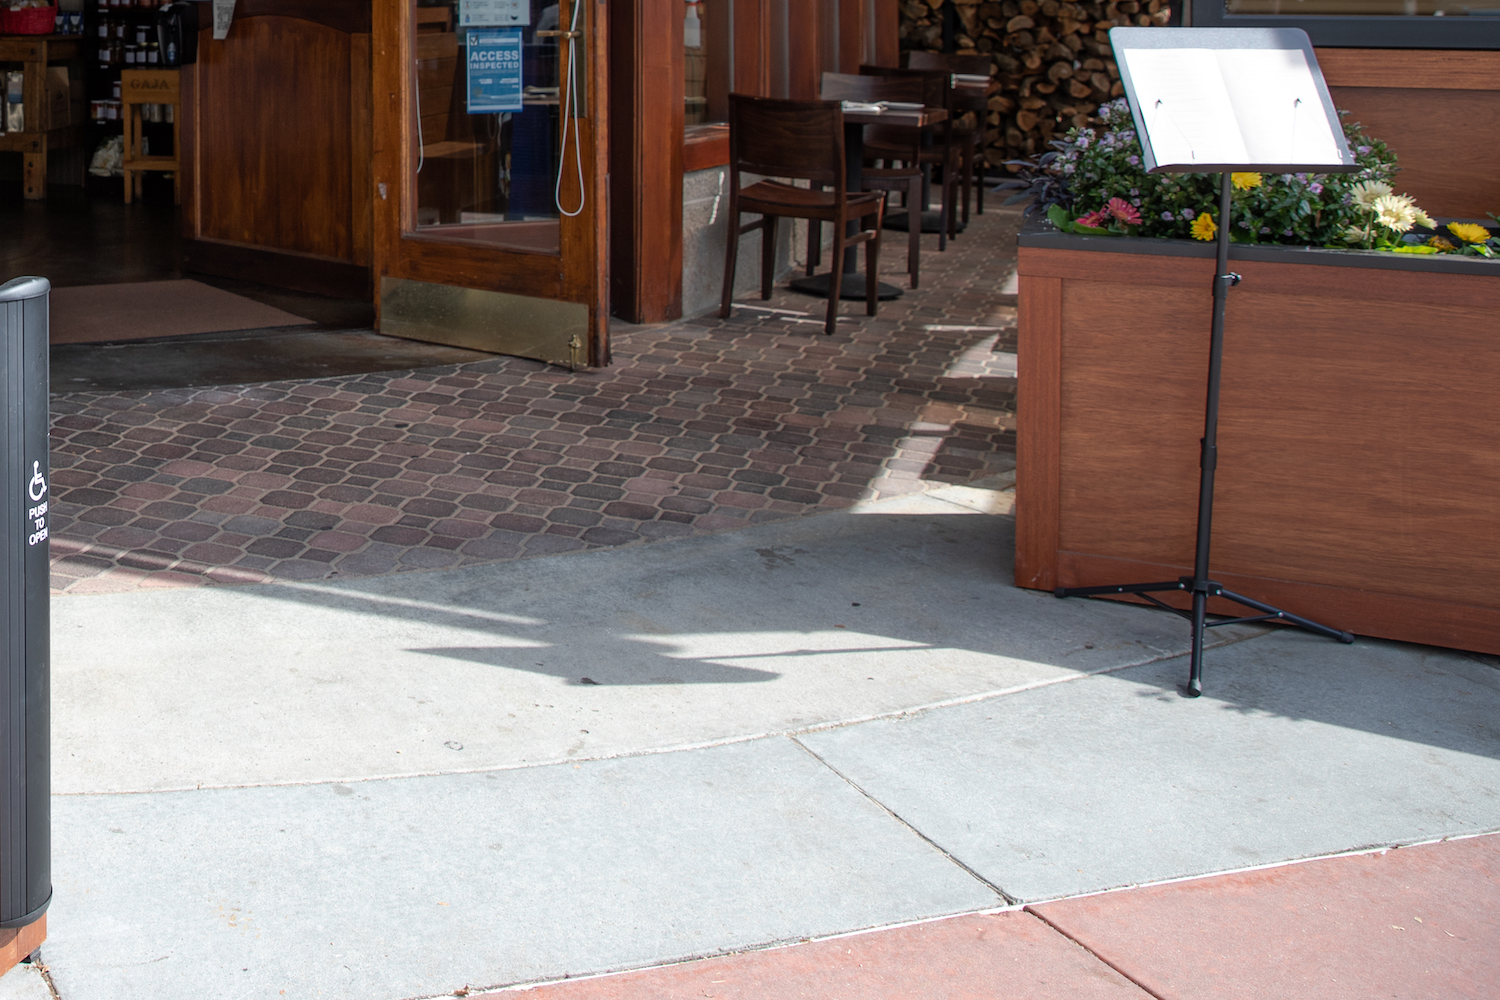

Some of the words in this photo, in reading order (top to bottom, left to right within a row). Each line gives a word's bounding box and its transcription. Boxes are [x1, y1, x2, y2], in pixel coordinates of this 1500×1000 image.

[470, 50, 519, 62] ACCESS
[470, 61, 519, 70] INSPECTED
[130, 78, 170, 90] GAJA
[28, 501, 48, 520] PUSH
[34, 516, 45, 531] TO
[28, 527, 48, 546] OPEN
